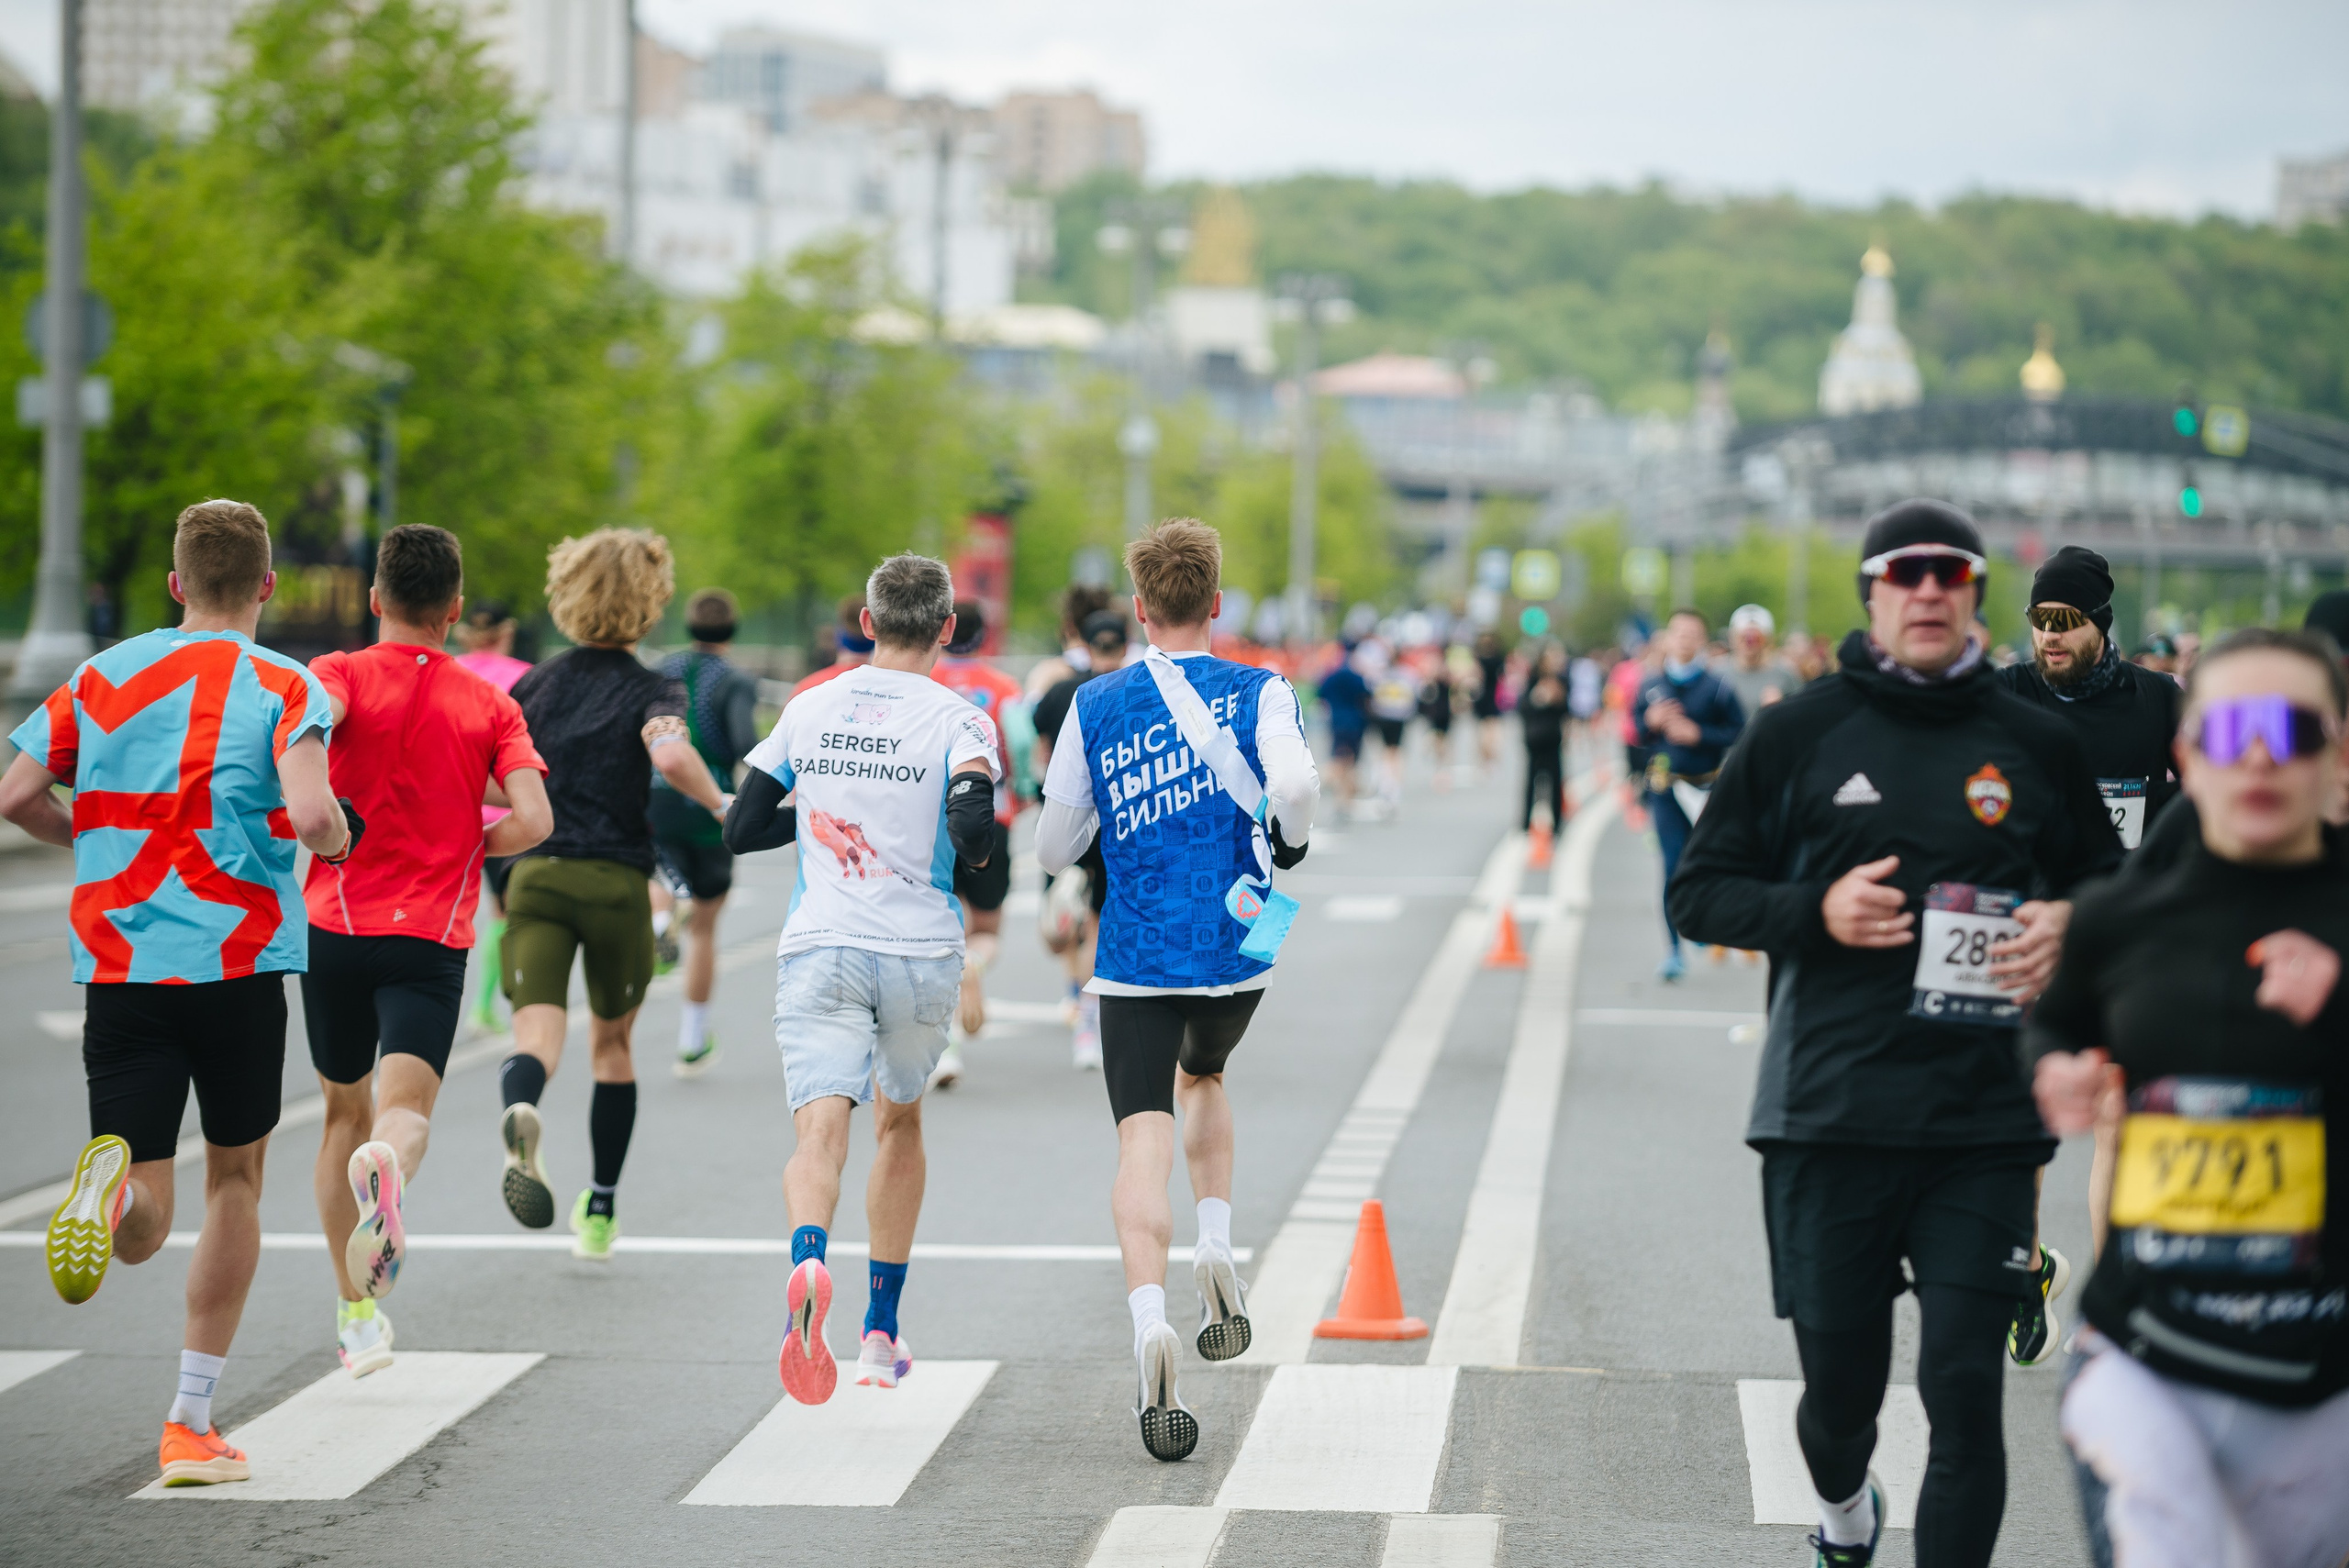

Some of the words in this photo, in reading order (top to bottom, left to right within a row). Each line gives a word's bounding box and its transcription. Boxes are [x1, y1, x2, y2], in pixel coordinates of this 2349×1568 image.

[820, 733, 902, 754] SERGEY
[1100, 691, 1239, 780] БЫСТЕЕ
[795, 758, 927, 783] BABUSHINOV
[1116, 769, 1227, 841] СИЛЬН
[863, 934, 894, 942] КОМАНДА
[1945, 928, 2021, 966] 28
